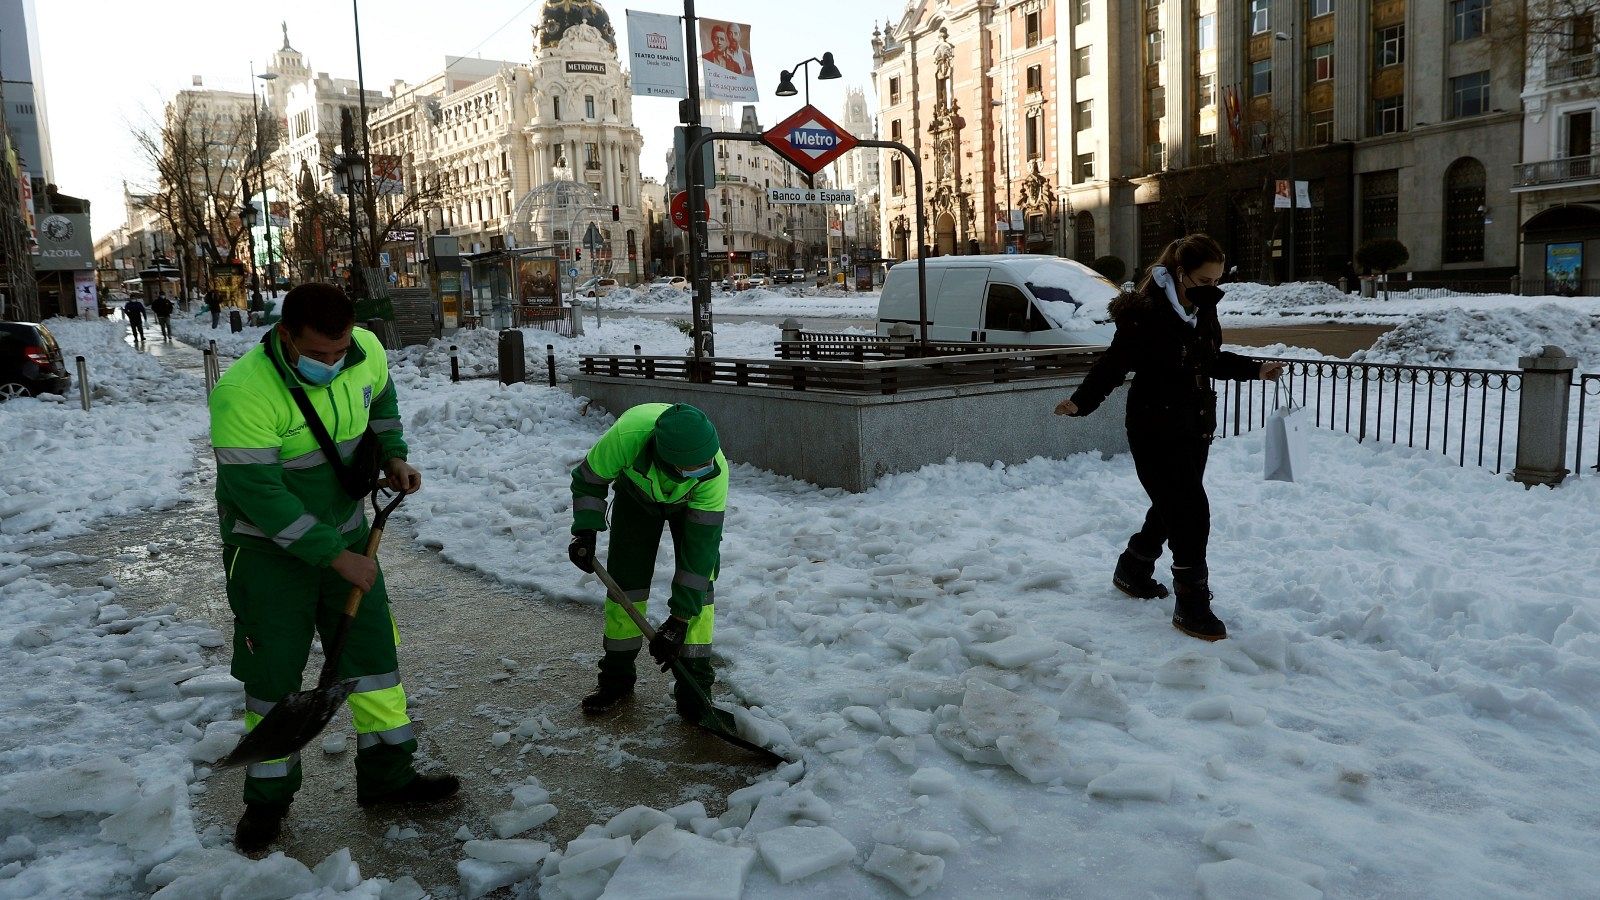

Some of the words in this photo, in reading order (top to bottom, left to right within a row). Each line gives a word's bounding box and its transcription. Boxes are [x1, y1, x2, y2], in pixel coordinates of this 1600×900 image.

[656, 54, 680, 62] ESPAÑOL
[568, 63, 605, 72] METROPOLIS
[794, 131, 833, 146] Metro
[772, 190, 801, 201] Banco
[804, 191, 816, 201] de
[820, 191, 851, 202] España
[42, 249, 82, 258] AZOTEA
